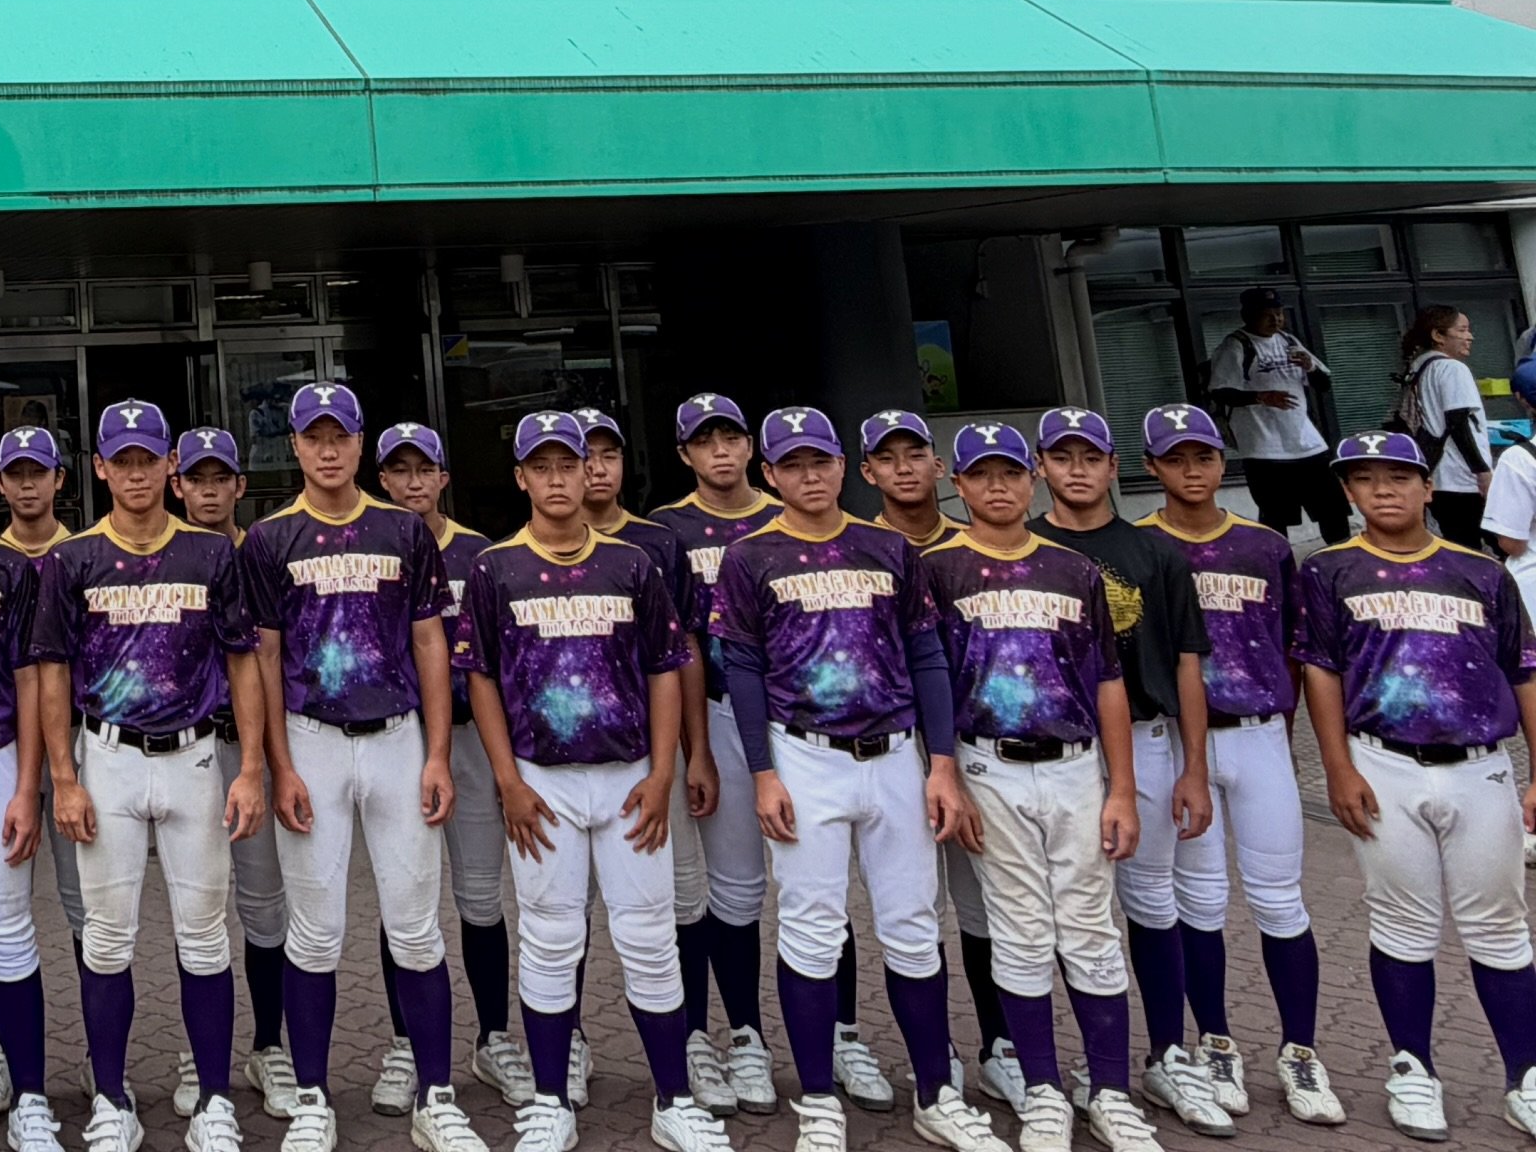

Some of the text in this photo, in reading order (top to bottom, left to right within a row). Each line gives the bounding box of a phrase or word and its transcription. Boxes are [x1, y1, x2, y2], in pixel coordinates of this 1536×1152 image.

[313, 387, 336, 405] Y
[693, 393, 717, 412] Y
[119, 408, 143, 428] Y
[535, 414, 560, 432] Y
[577, 410, 602, 424] Y
[782, 411, 807, 432] Y
[879, 411, 902, 426] Y
[1061, 410, 1087, 428] Y
[1164, 410, 1190, 429] Y
[14, 430, 37, 448] Y
[196, 431, 218, 448] Y
[395, 423, 418, 437] Y
[975, 426, 1001, 444] Y
[1359, 435, 1387, 453] Y
[287, 554, 402, 586] YAMAGUCHI
[769, 570, 894, 603] YAMAGUCHI
[1191, 572, 1268, 603] GUCHI
[84, 584, 207, 612] YAMAGUCHI
[953, 590, 1083, 623] YAMAGUCHI
[509, 596, 634, 626] YAMAGUCHI
[1344, 591, 1485, 627] YAMAGUCHI
